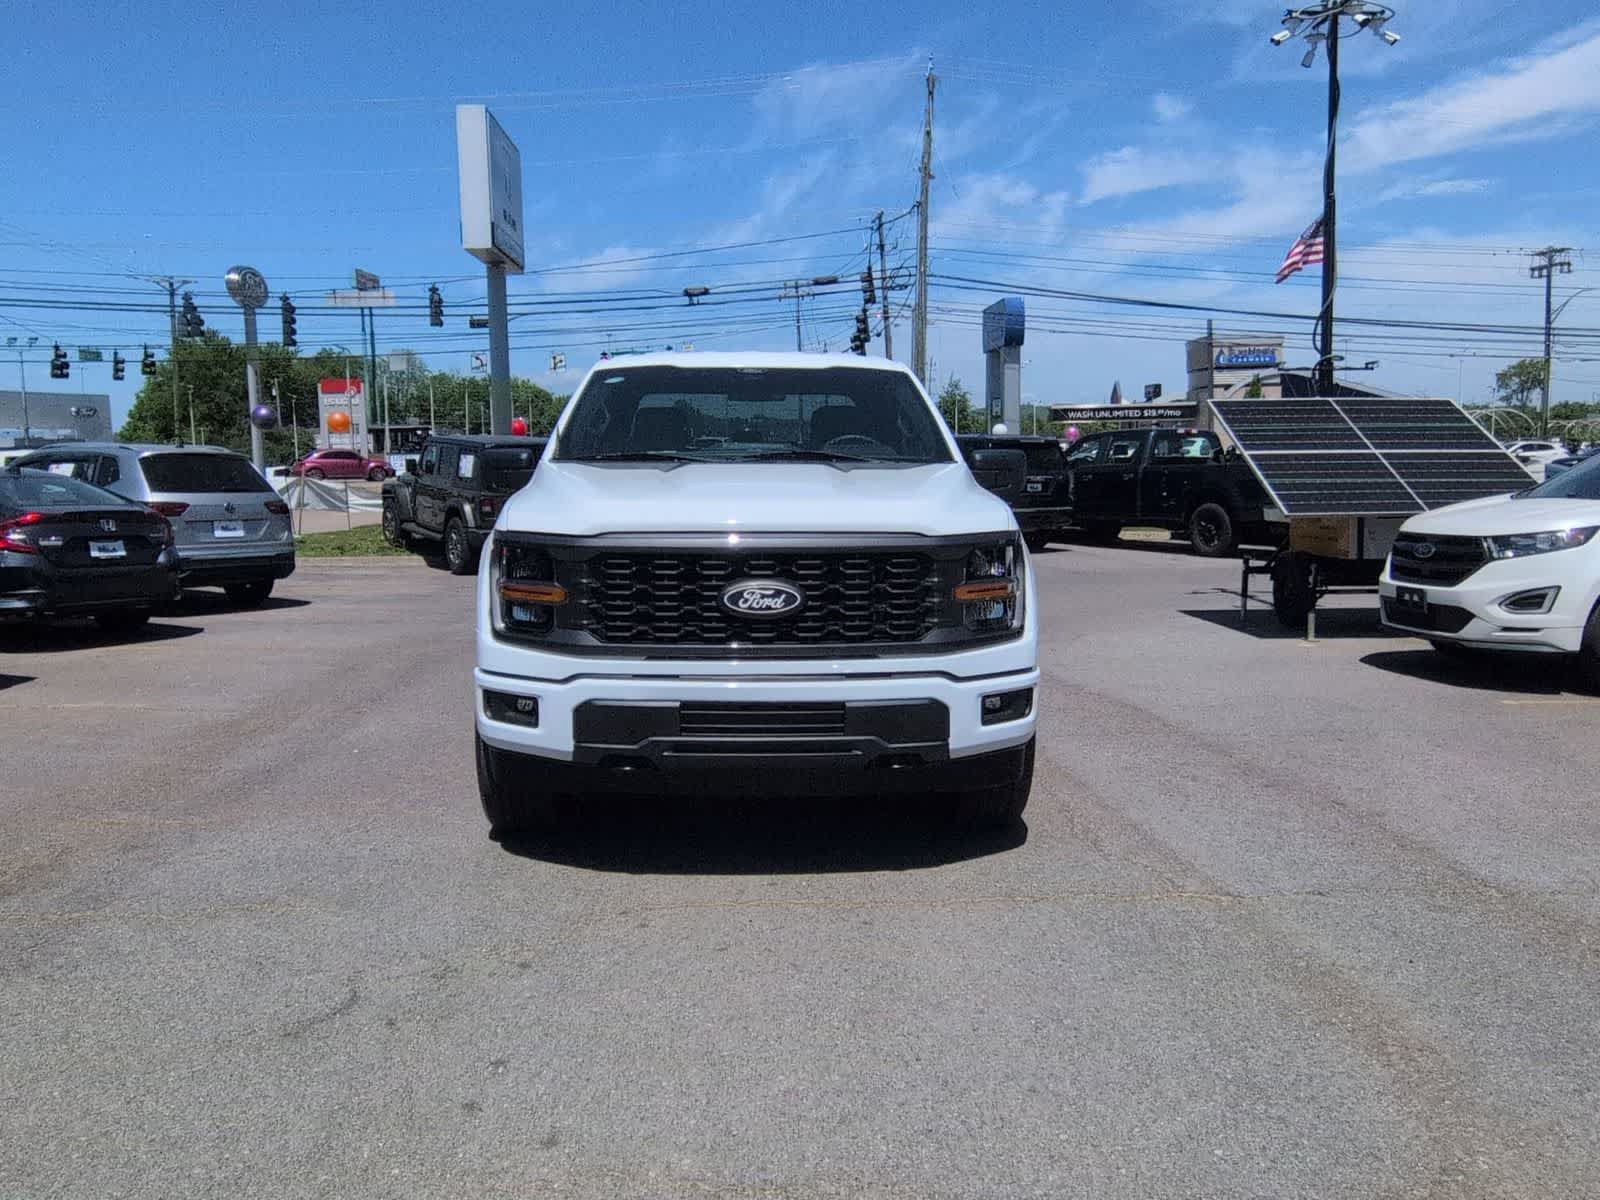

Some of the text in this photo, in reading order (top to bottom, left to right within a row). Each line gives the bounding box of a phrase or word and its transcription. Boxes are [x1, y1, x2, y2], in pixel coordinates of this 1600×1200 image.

[1067, 410, 1094, 419] WASH
[1095, 410, 1141, 418] UNLIMITED
[738, 589, 786, 609] Ford
